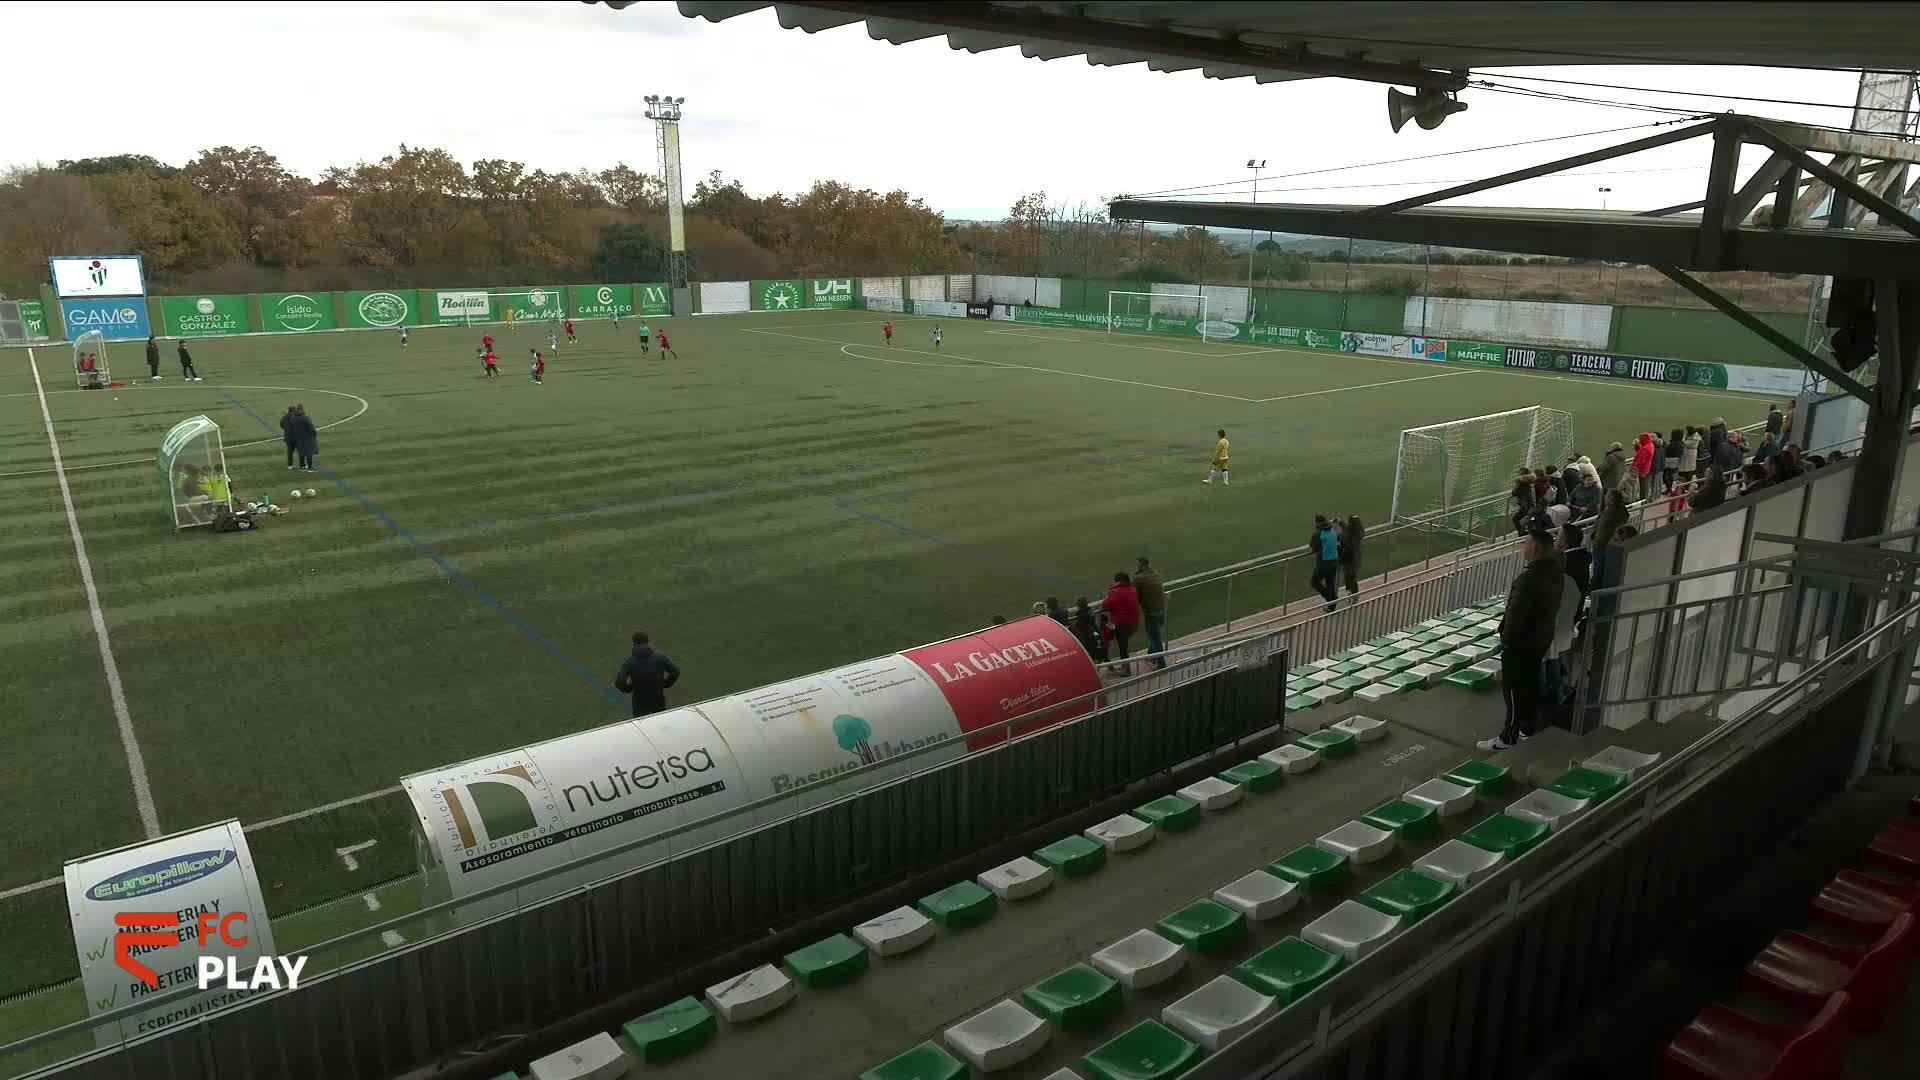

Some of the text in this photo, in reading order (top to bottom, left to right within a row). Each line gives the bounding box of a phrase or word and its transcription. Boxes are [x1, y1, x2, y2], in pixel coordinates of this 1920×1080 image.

[828, 294, 851, 302] HESSEN
[286, 305, 312, 314] Isidro
[578, 304, 632, 313] CARRASCO
[69, 308, 138, 326] GAMO
[179, 314, 221, 323] CASTRO
[1457, 350, 1501, 361] MAPFRE
[1571, 354, 1611, 370] TERCERA
[931, 661, 976, 683] LA
[969, 638, 1059, 672] GACETA
[562, 747, 716, 812] nutersa
[464, 836, 554, 872] Asesoramiento
[563, 813, 625, 839] veterinario
[94, 847, 227, 897] Europillow
[210, 899, 221, 912] Y
